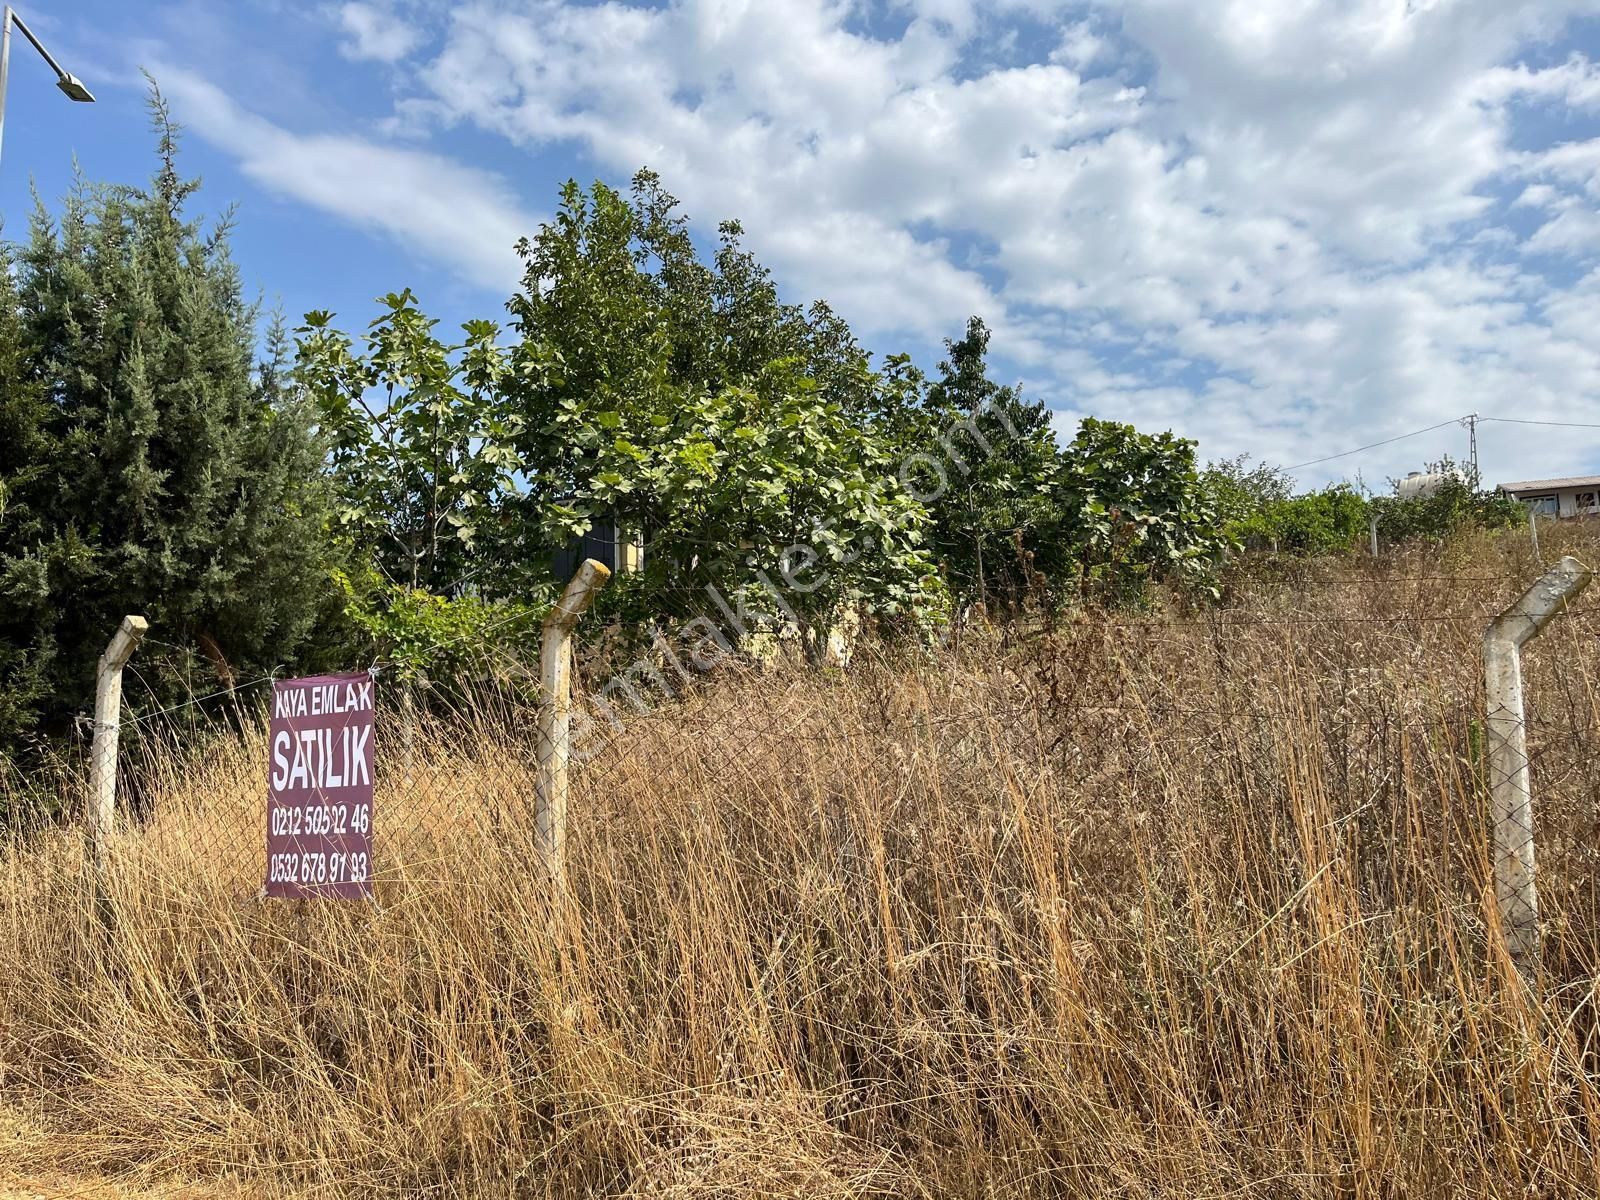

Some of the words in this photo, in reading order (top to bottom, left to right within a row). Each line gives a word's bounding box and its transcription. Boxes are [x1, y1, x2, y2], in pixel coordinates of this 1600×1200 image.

[275, 688, 307, 718] KAYA
[311, 682, 372, 715] EMLAK
[272, 724, 371, 792] SATILIK
[272, 806, 301, 836] 0212
[304, 805, 331, 835] 505
[331, 804, 347, 834] 22
[351, 803, 369, 834] 46
[270, 852, 299, 883] 0532
[301, 851, 326, 883] 678
[329, 851, 347, 884] 91
[350, 851, 368, 883] 93
